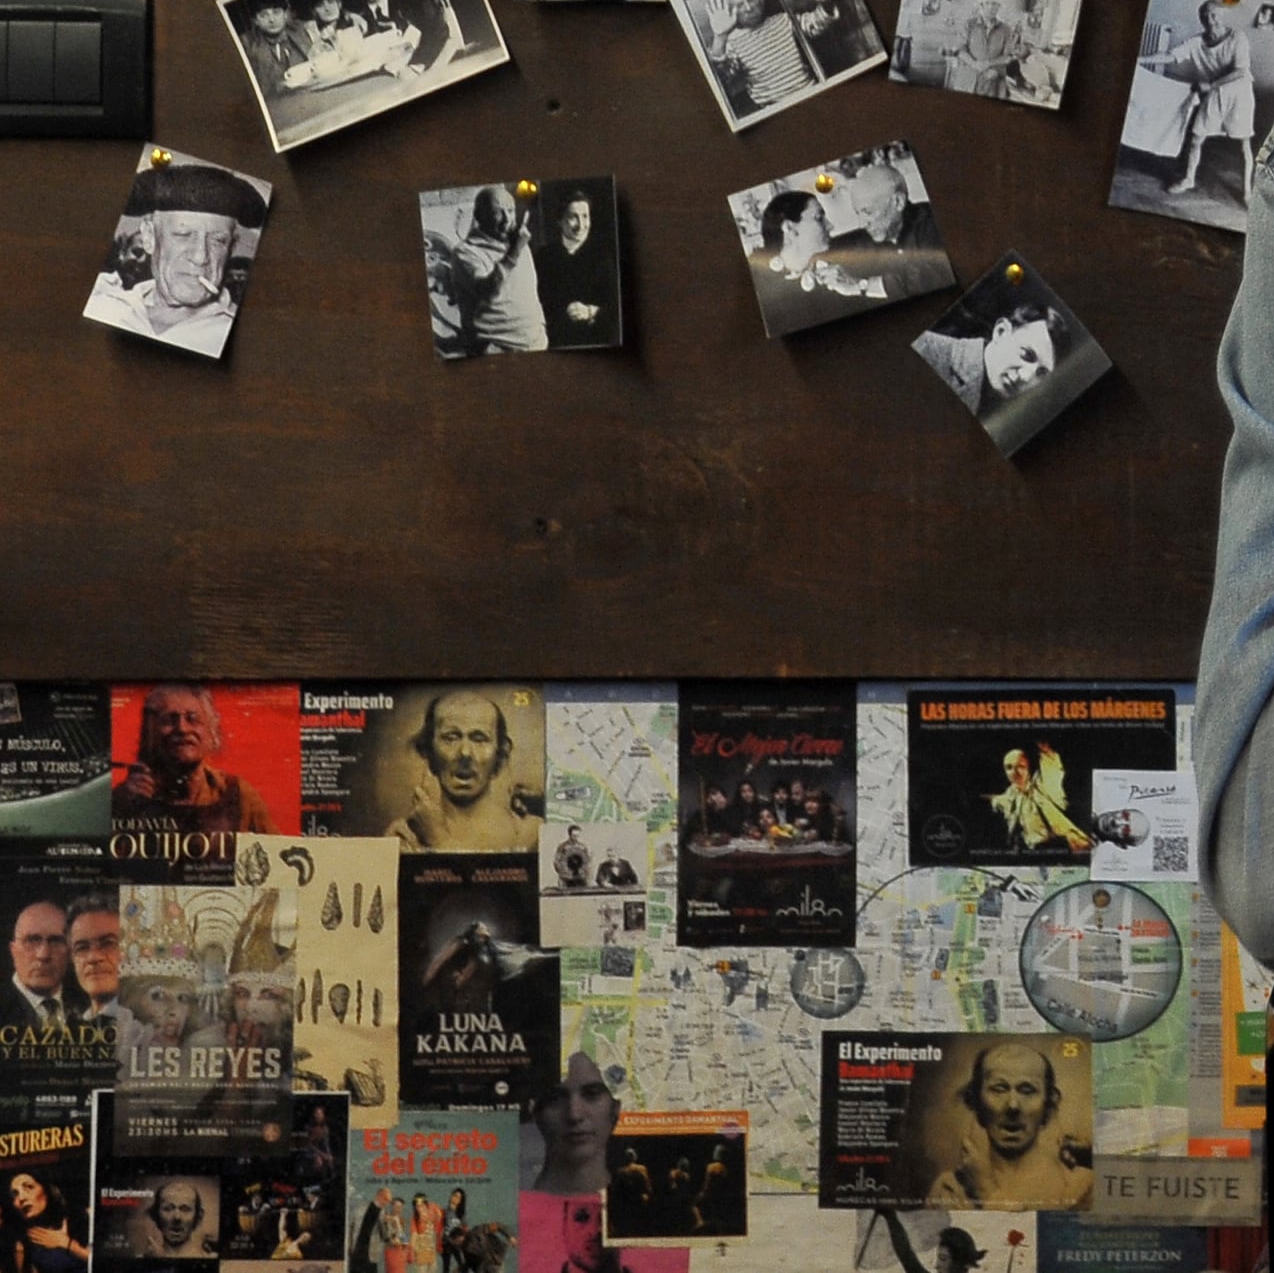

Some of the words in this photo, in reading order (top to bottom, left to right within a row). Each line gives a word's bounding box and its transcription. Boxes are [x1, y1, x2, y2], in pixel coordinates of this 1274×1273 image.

[304, 691, 394, 713] Experimento
[920, 702, 945, 720] LAS
[949, 702, 995, 720] HORAS
[997, 701, 1041, 719] FUERA
[1043, 701, 1060, 719] DE
[1063, 701, 1088, 719] LOS
[1090, 697, 1167, 719] MÁRGENES
[7, 735, 66, 753] MÚSCULO,
[22, 761, 38, 774] UN
[43, 761, 84, 775] VIRUS.
[439, 1013, 503, 1033] LUNA
[0, 1025, 118, 1046] CAZADO
[416, 1034, 527, 1054] KAKANA
[2, 1047, 12, 1059] Y
[47, 1047, 92, 1059] BUEN
[130, 1046, 182, 1078] LES
[190, 1046, 282, 1078] REYES
[839, 1041, 852, 1060] El
[854, 1041, 942, 1065] Experimento
[128, 1118, 178, 1127] VIERNES
[0, 1124, 84, 1157] STURERAS
[363, 1128, 389, 1152] El
[394, 1126, 498, 1152] secreto
[372, 1151, 416, 1175] del
[420, 1151, 489, 1175] éxito
[1103, 1175, 1135, 1198] TE
[1147, 1176, 1240, 1200] FUISTE
[1056, 1249, 1103, 1262] FREDY
